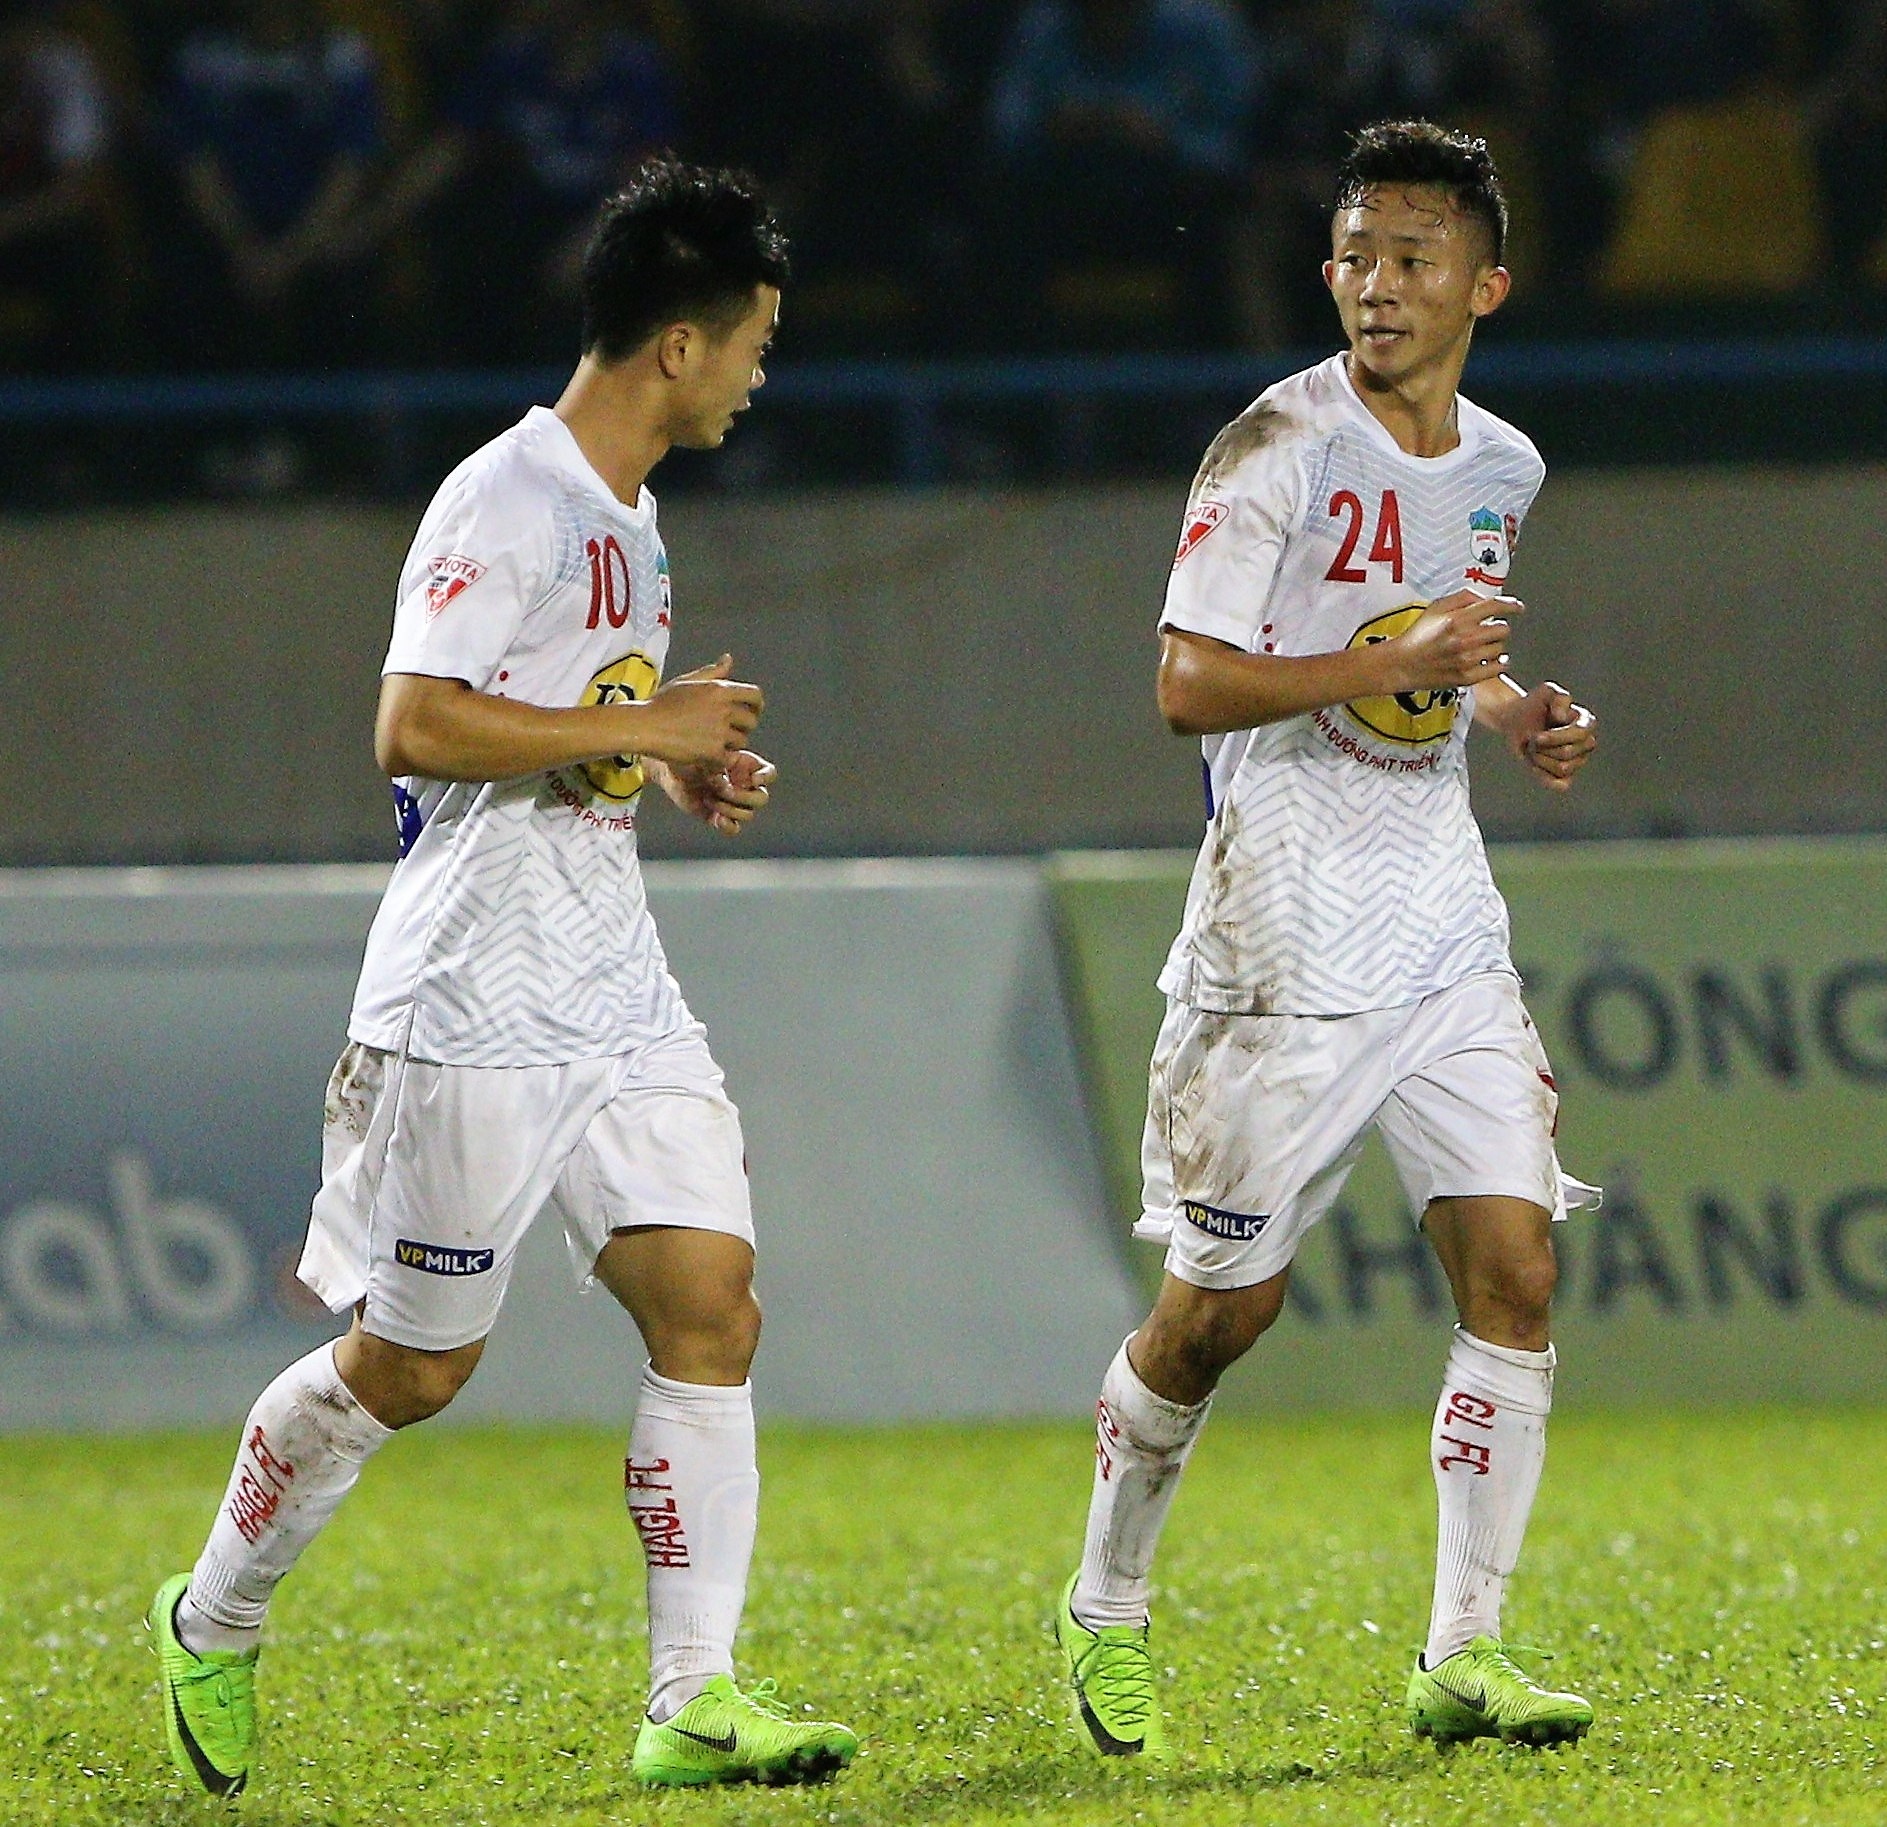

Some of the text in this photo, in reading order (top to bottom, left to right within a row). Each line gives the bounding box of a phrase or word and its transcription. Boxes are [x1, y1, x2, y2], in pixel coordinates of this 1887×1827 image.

[585, 534, 630, 629] 10
[1324, 488, 1403, 583] 24
[1521, 935, 1887, 1095] ÔNG
[398, 1244, 490, 1273] VPMILK
[1188, 1203, 1268, 1238] VPMILK
[229, 1425, 295, 1545] HAGL FC
[1439, 1434, 1490, 1475] FC
[624, 1457, 690, 1568] HAGL FC
